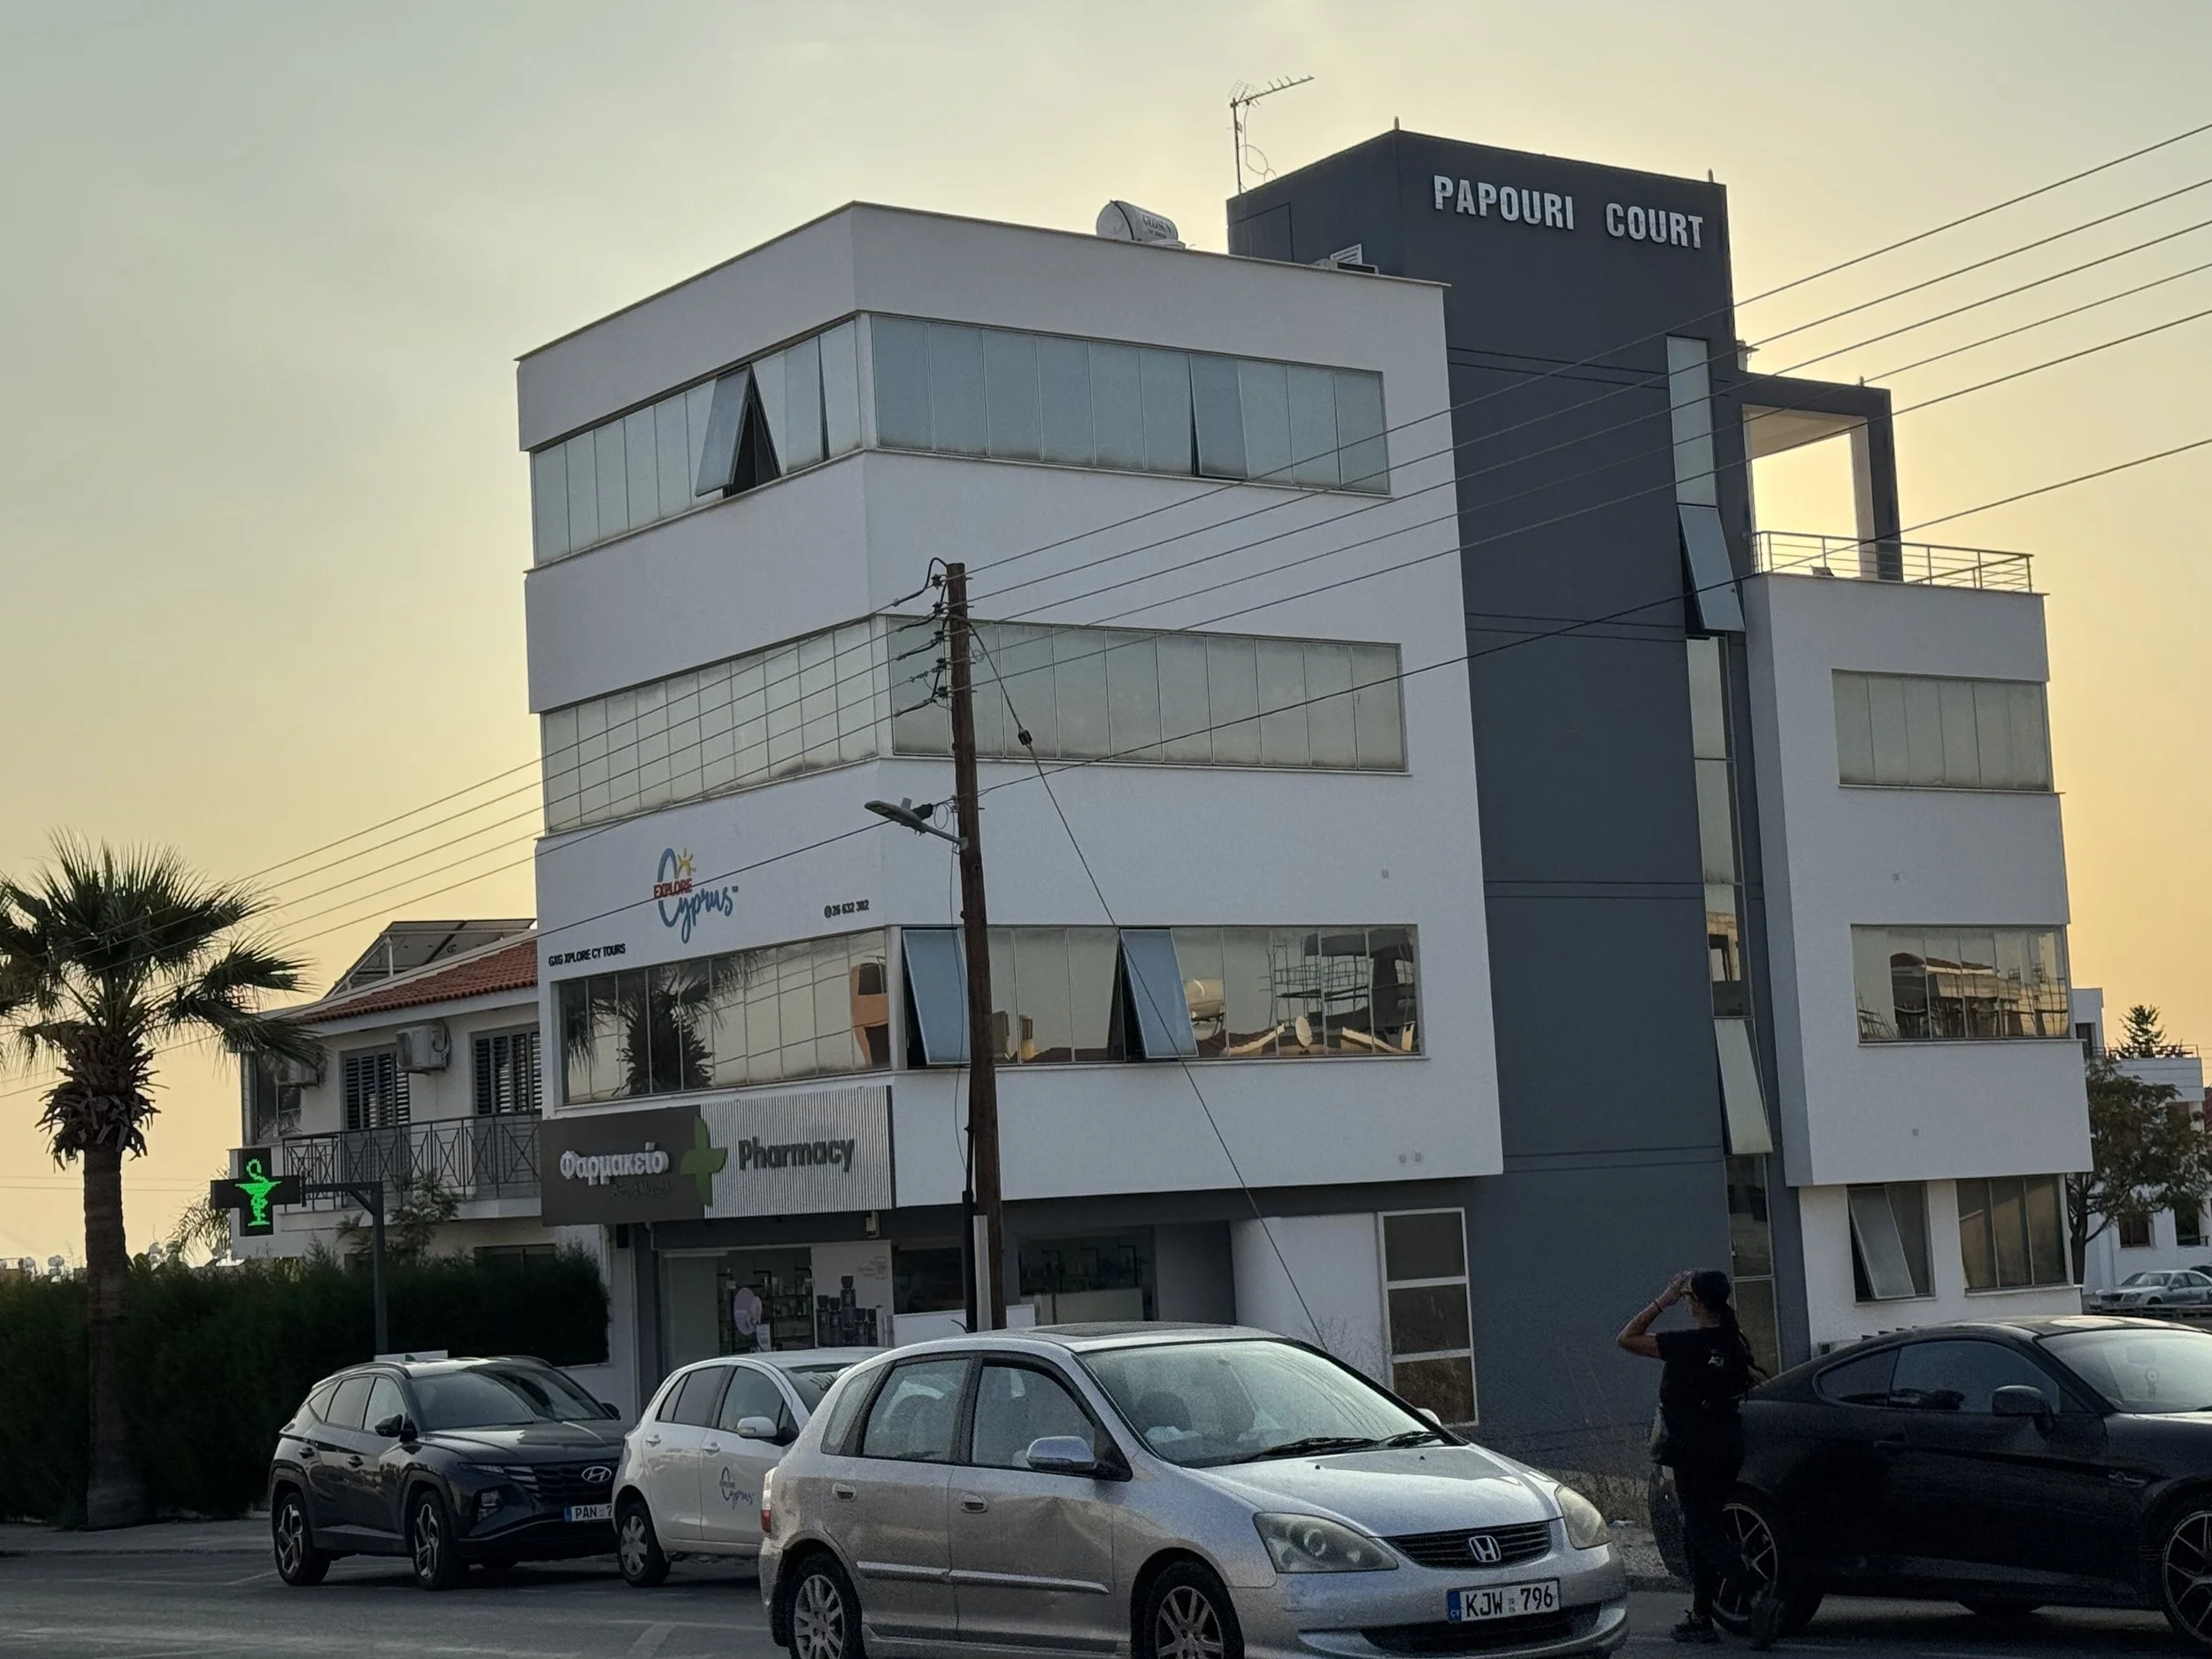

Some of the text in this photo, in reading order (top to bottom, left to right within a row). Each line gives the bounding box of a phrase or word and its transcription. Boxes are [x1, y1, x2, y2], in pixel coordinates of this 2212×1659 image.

[1432, 174, 1703, 249] PAPOURI COURT
[653, 878, 693, 899] EXPLORE
[657, 848, 733, 944] Cyprus
[564, 949, 591, 964] XPLORE
[591, 947, 602, 959] CY
[602, 942, 626, 957] TOURS
[560, 1141, 669, 1186] Φαρμακείο
[738, 1137, 855, 1172] Pharmacy
[575, 1506, 597, 1519] PAN
[1465, 1592, 1503, 1617] KJW
[1520, 1585, 1554, 1611] 796
